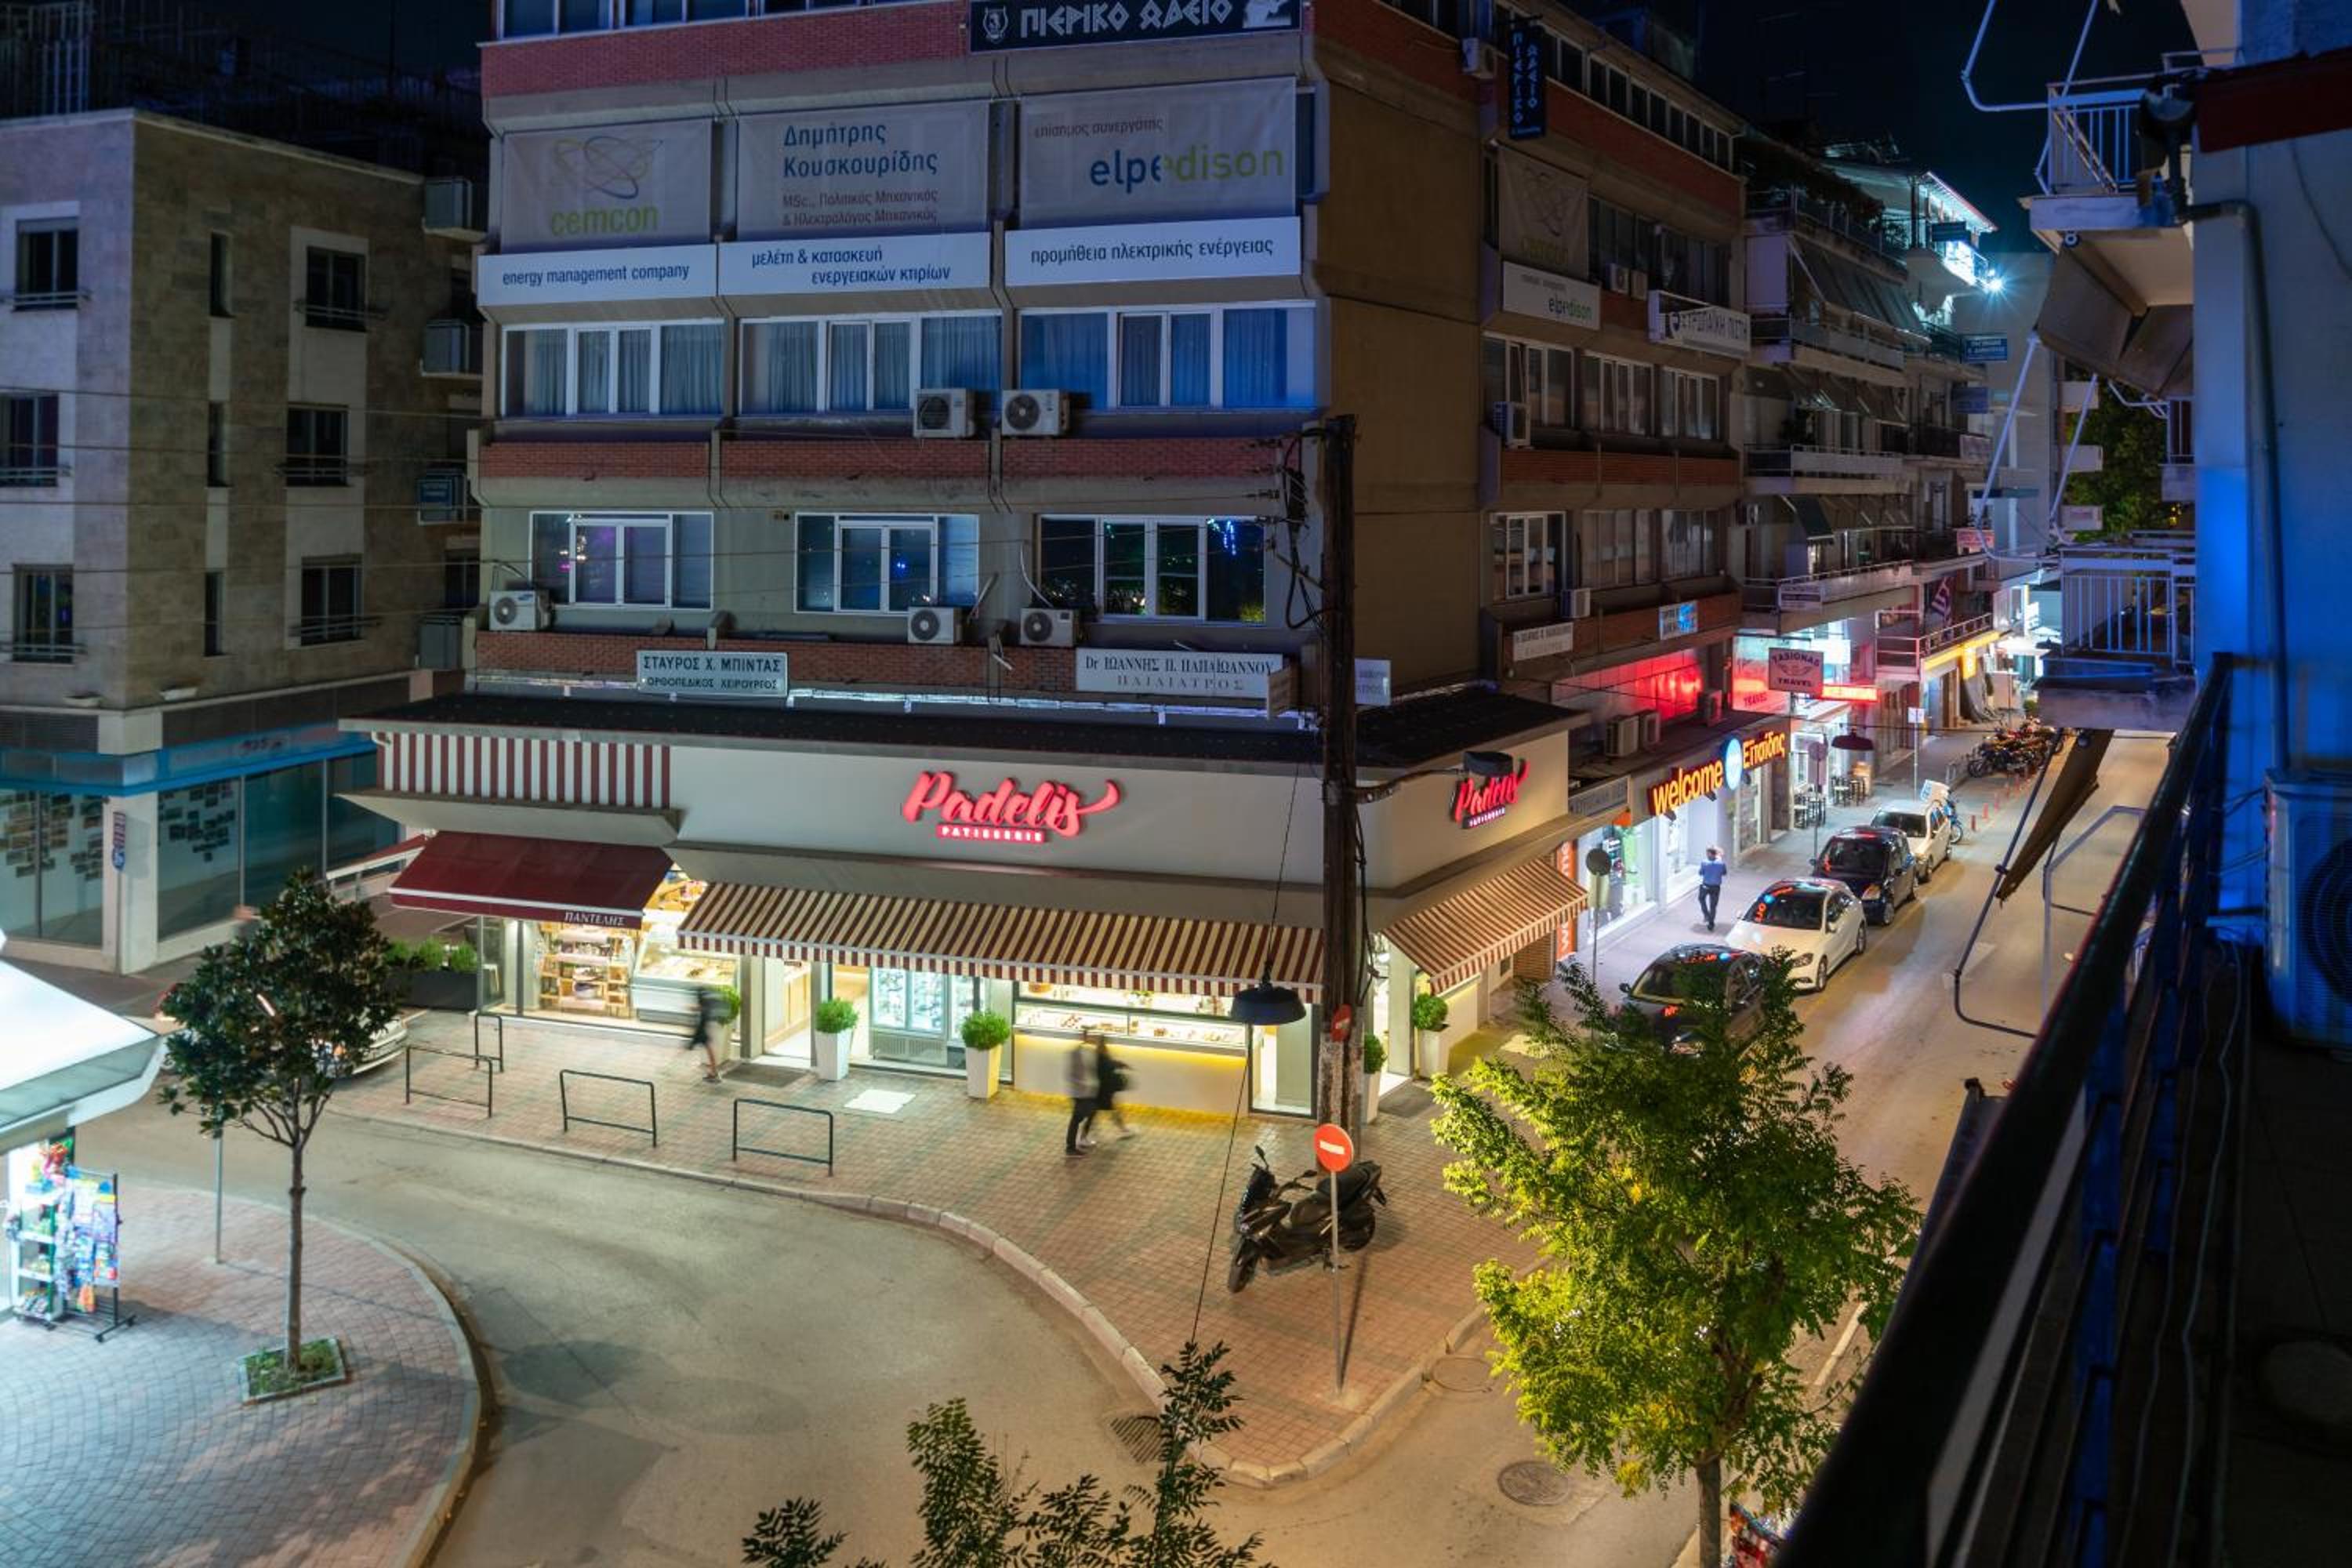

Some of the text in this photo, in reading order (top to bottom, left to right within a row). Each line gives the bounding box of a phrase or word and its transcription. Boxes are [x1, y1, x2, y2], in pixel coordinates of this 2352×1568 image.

[1020, 2, 1131, 38] ΠΙΕΡΙΚΟ
[783, 122, 887, 148] Δημήτρης
[783, 151, 938, 178] Κουσκουρίδης
[550, 205, 658, 237] cemcon
[751, 245, 883, 268] μελέτη & κατασκευή
[1030, 237, 1274, 267] προμήθεια ηλεκτρικής ενέργειας
[502, 265, 690, 287] energy management company
[811, 264, 951, 286] ενεργειακών κτιρίων
[643, 656, 781, 673] ΣΤΑΥΡΟΣ Χ. ΜΠΙΝΤΑΣ
[1085, 655, 1098, 670] Dr
[1104, 657, 1160, 672] ΙΩΑΝΝΗΣ
[647, 677, 778, 690] ΟΡΘΟΠΕΔΙΚΟΣ ΧΕΙΡΟΥΡΓΟΣ
[1653, 760, 1724, 817] welcome
[564, 911, 625, 927] ΠΑΝΤΕΛΗΣ
